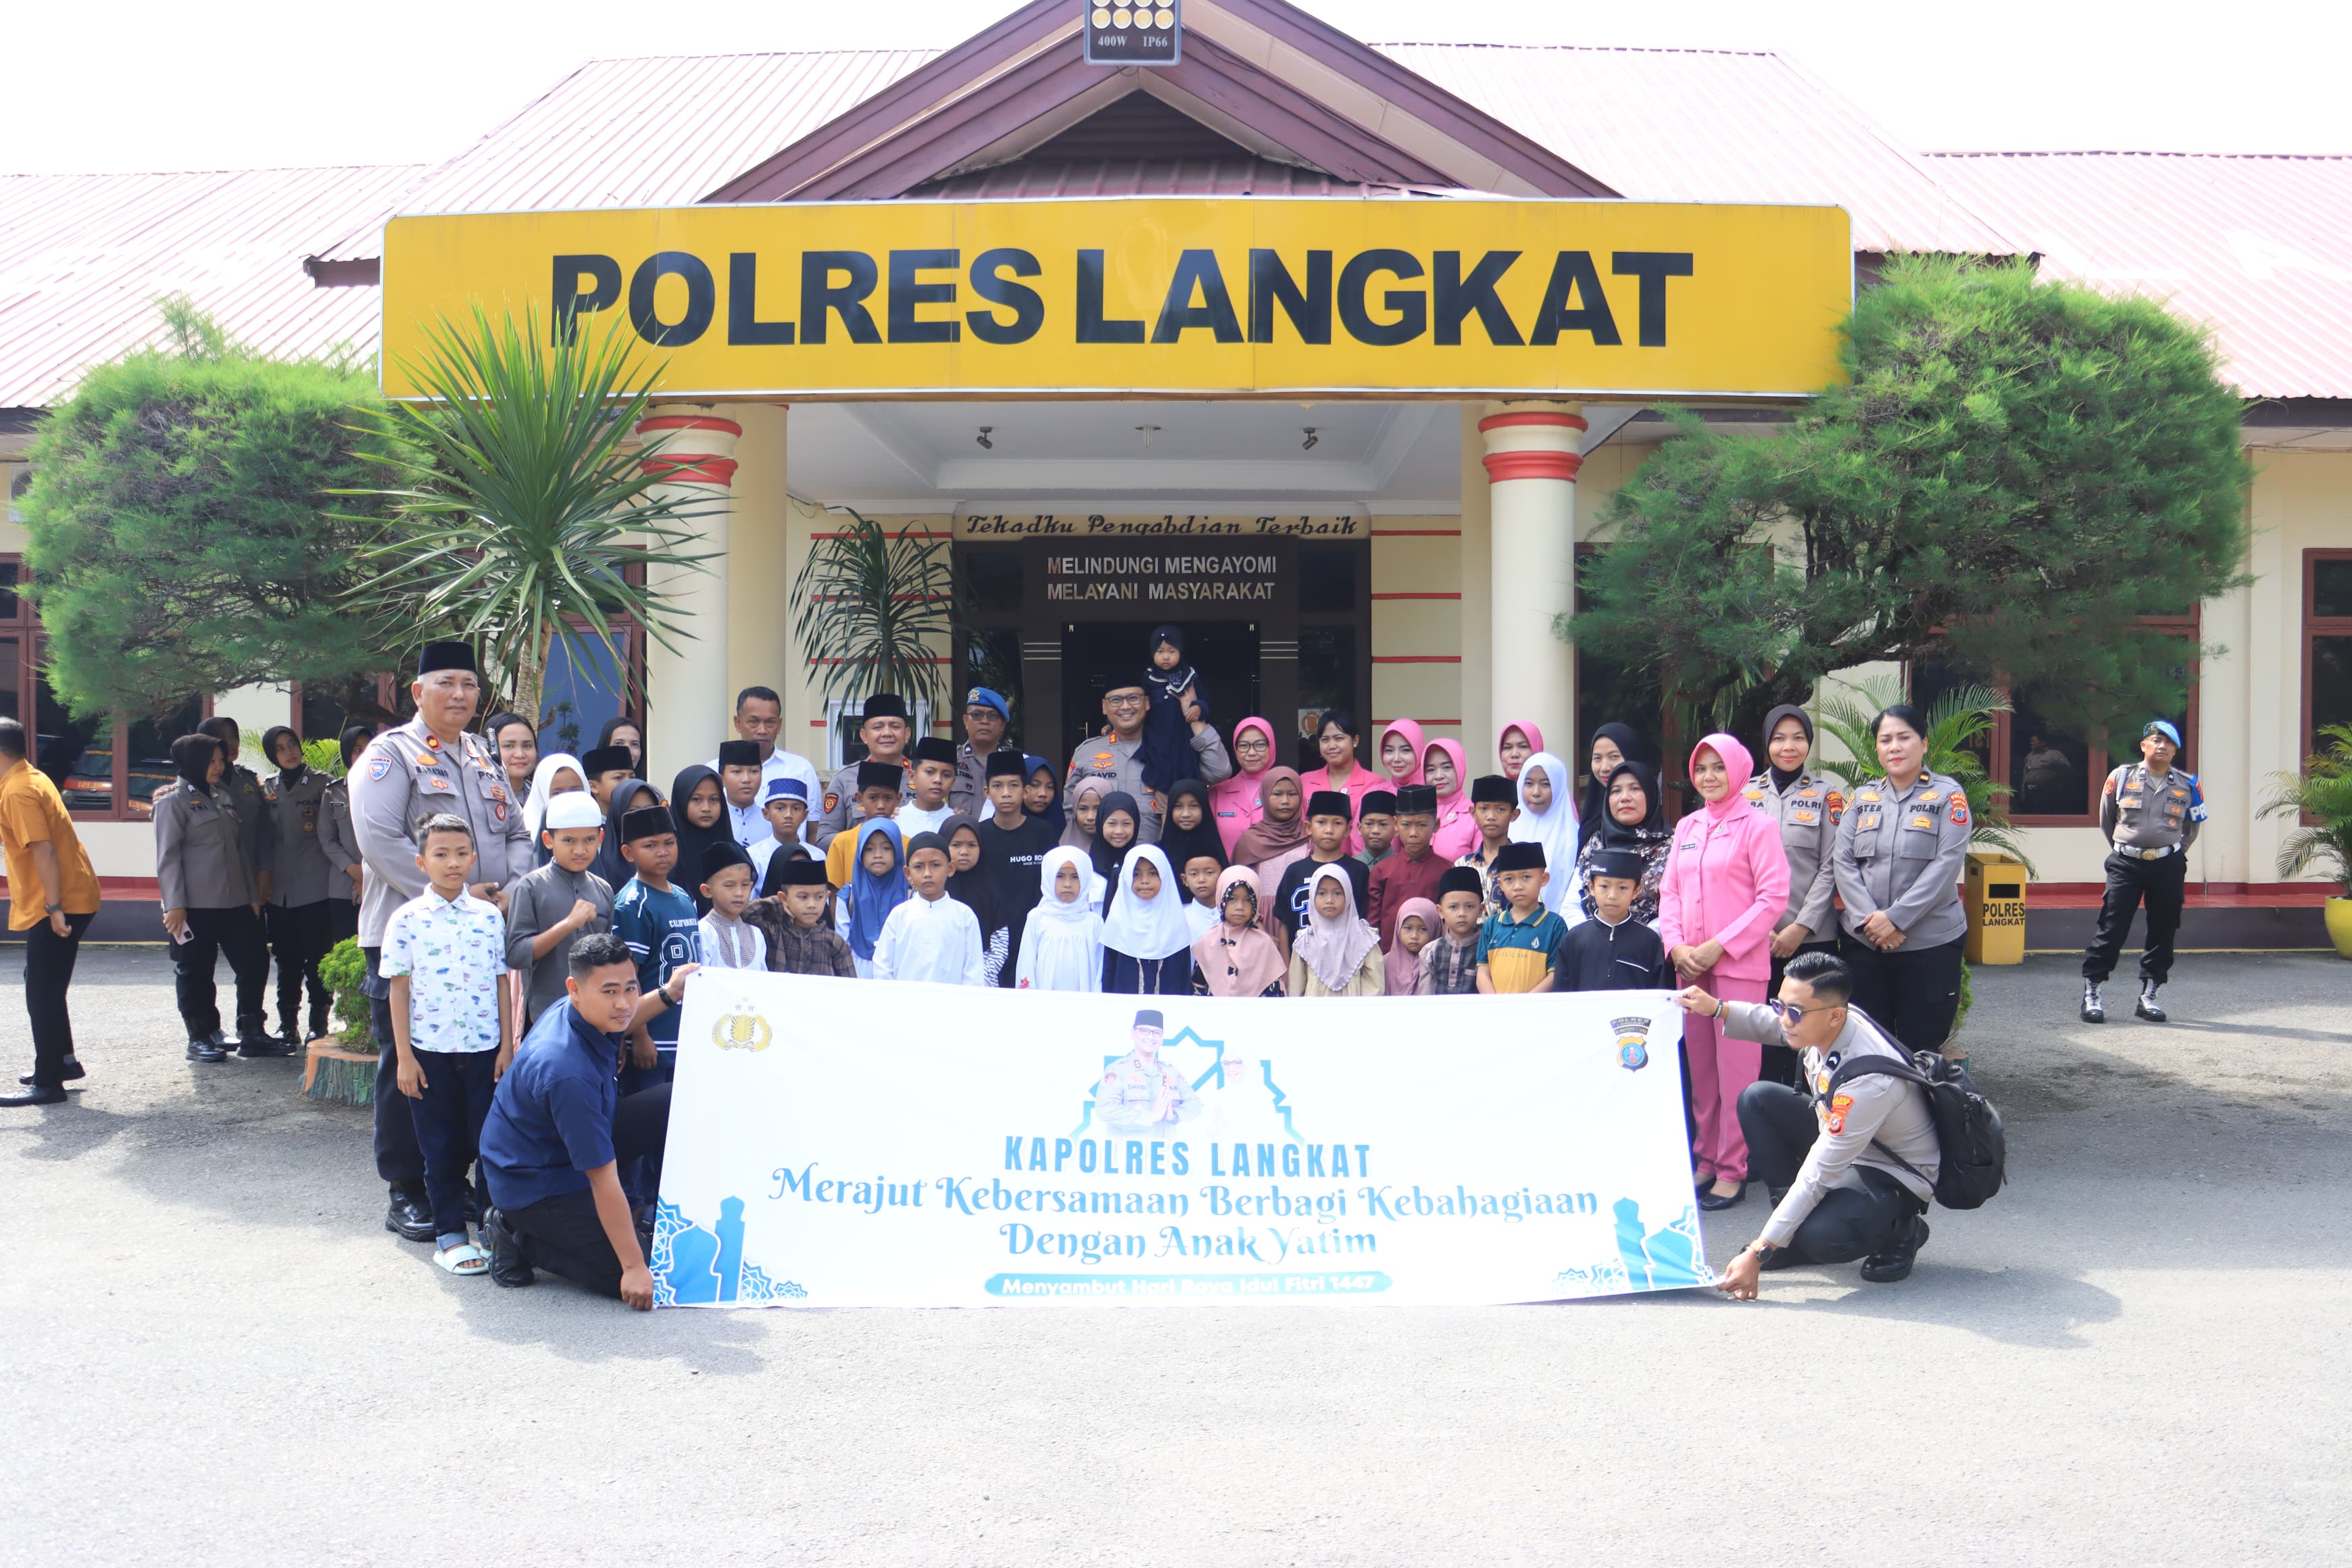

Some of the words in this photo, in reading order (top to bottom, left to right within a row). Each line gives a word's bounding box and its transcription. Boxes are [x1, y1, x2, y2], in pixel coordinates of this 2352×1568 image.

[1098, 36, 1127, 47] 400W
[1142, 36, 1168, 47] IP66
[552, 248, 1044, 348] POLRES
[1077, 247, 1693, 348] LANGKAT
[966, 515, 1077, 534] Tekadku
[1255, 516, 1358, 535] Terbaik
[1048, 557, 1158, 574] MELINDUNGI
[1165, 556, 1277, 574] MENGAYOMI
[1048, 583, 1137, 600] MELAYANI
[1148, 582, 1275, 600] MASYARAKAT
[1790, 800, 1821, 810] POLRI
[1909, 804, 1941, 815] POLRI
[2166, 796, 2187, 806] POLRI
[1010, 855, 1032, 863] HUGO
[1982, 902, 2026, 918] POLRES
[1982, 917, 2026, 927] LANGKAT
[1005, 1135, 1189, 1177] KAPOLRES
[1210, 1143, 1370, 1178] LANGKAT
[768, 1162, 927, 1214] Merajut
[935, 1177, 1189, 1217] Kebersamaan
[1200, 1185, 1347, 1224] Berbagi
[1358, 1185, 1597, 1223] Kebahagiaan
[1000, 1223, 1145, 1264] Dengan
[1154, 1225, 1267, 1262] Anak
[1266, 1227, 1377, 1265] Yatim
[1003, 1279, 1125, 1296] Menyambut
[1132, 1279, 1175, 1294] Hari
[1182, 1279, 1233, 1296] Raya
[1240, 1277, 1278, 1293] Idul
[1285, 1276, 1325, 1292] Fitri
[1329, 1275, 1374, 1290] 1447
